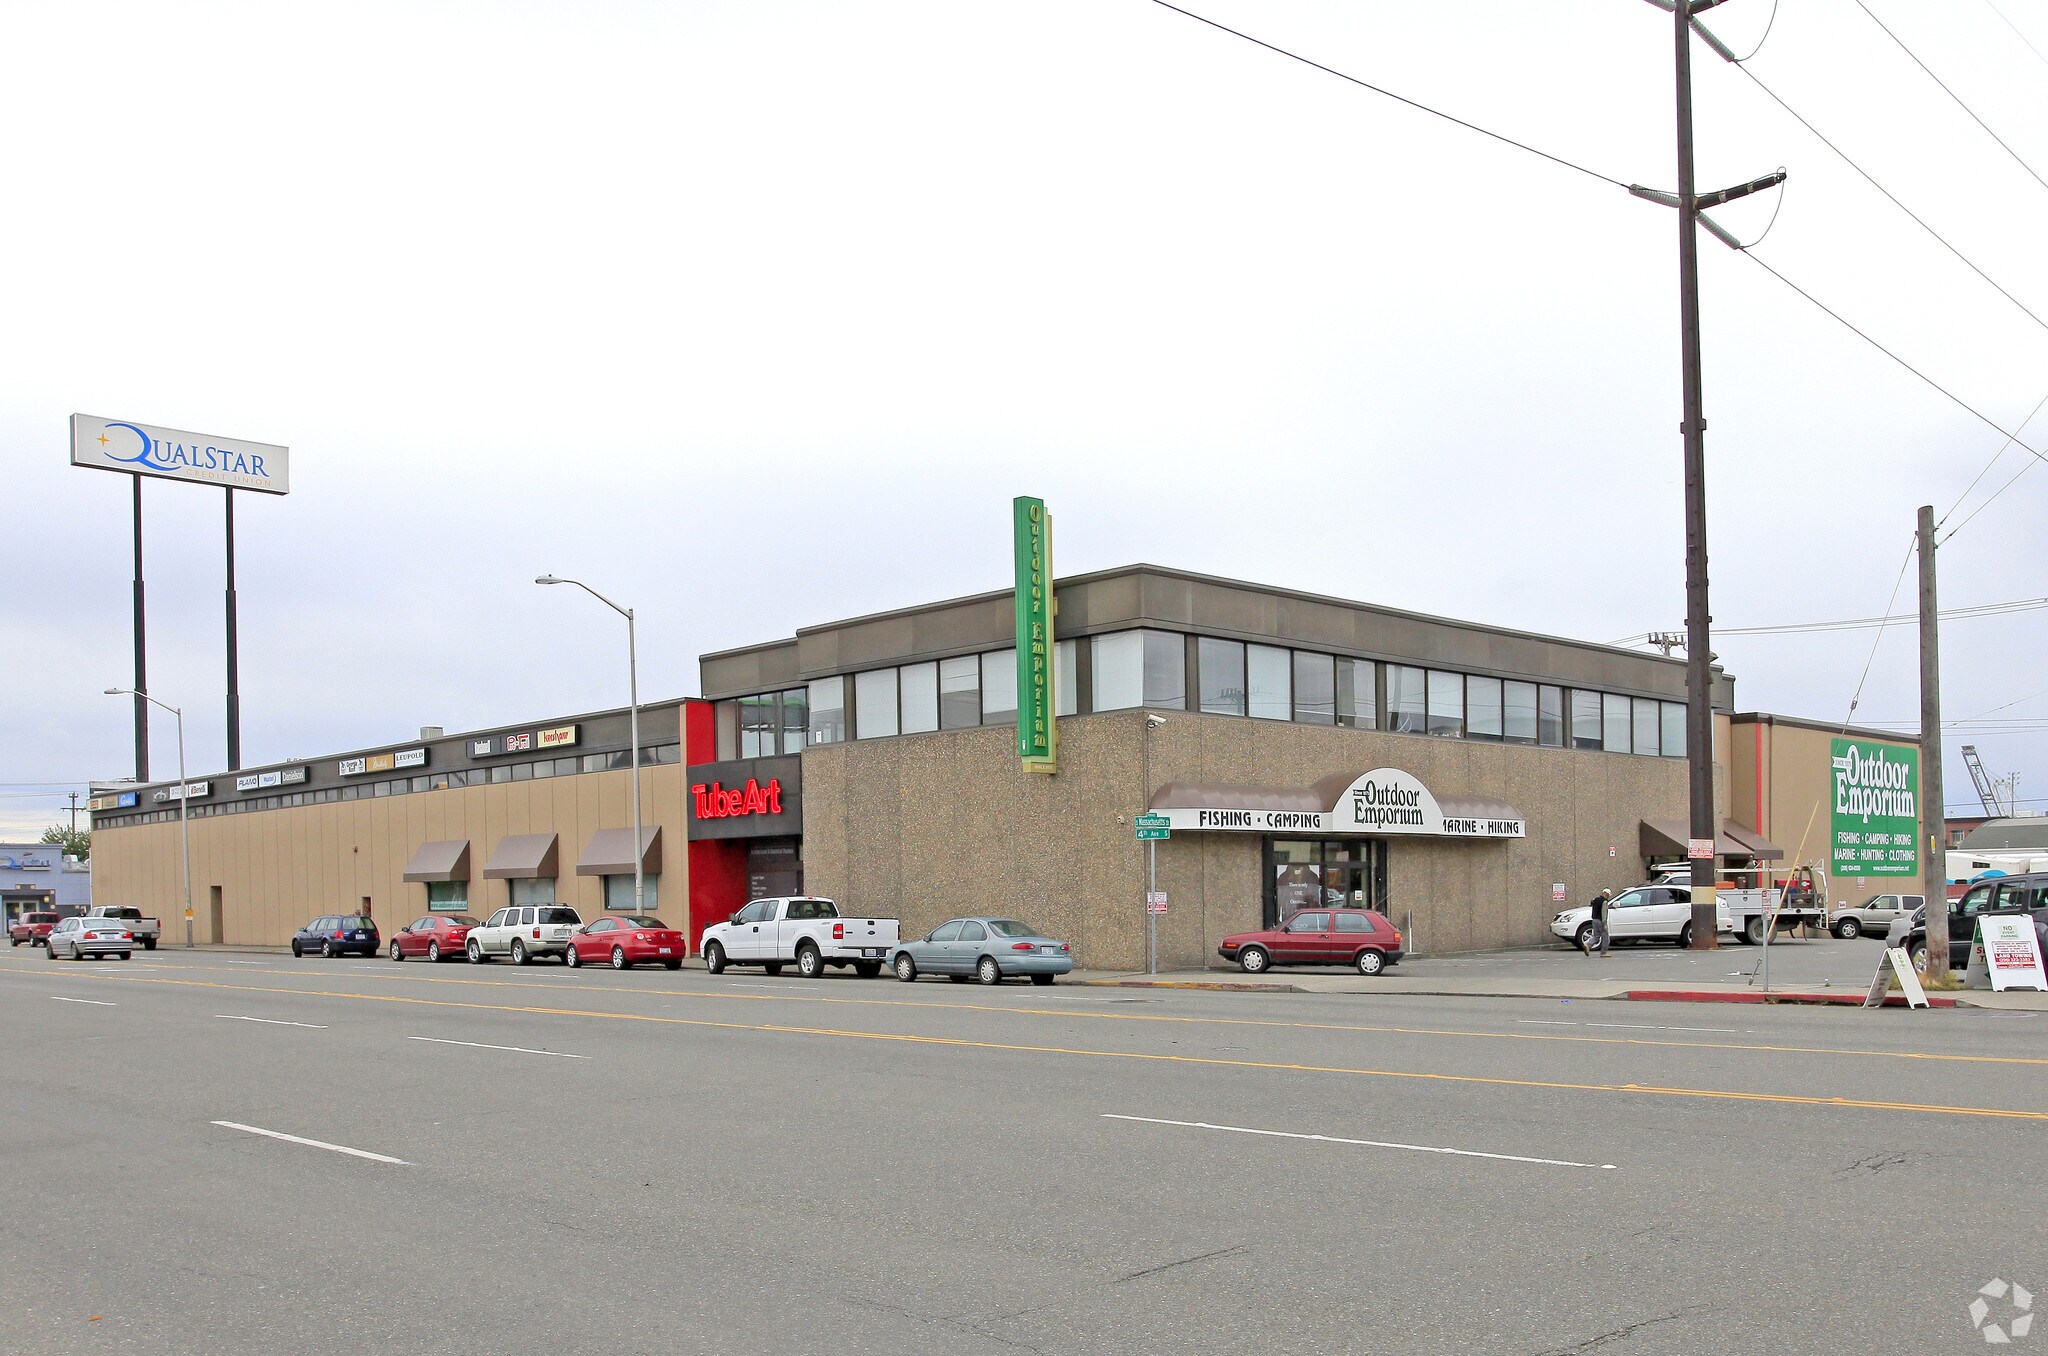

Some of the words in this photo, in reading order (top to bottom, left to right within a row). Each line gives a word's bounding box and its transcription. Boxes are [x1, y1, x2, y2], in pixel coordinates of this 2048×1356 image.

[186, 469, 227, 481] CREDIT
[234, 476, 272, 487] UNION
[1029, 504, 1042, 613] Outdoor
[1032, 622, 1047, 747] Emporium
[396, 752, 424, 761] LEUPOLD
[1846, 745, 1909, 790] Outdoor
[238, 778, 257, 787] PLANO
[1365, 780, 1420, 807] Outdoor
[1836, 771, 1916, 824] Emporium
[1138, 818, 1165, 826] Massachusetts
[1199, 810, 1251, 827] FISHING
[1266, 812, 1321, 829] CAMPING
[1353, 798, 1424, 829] Emporium
[1487, 820, 1519, 835] HIKING
[1837, 832, 1860, 844] FISHING
[1864, 833, 1889, 845] CAMPING
[1893, 834, 1912, 846] HIKING
[1834, 848, 1856, 860] MARINE
[1860, 849, 1884, 861] HUNTING
[1888, 850, 1915, 861] CLOTHING
